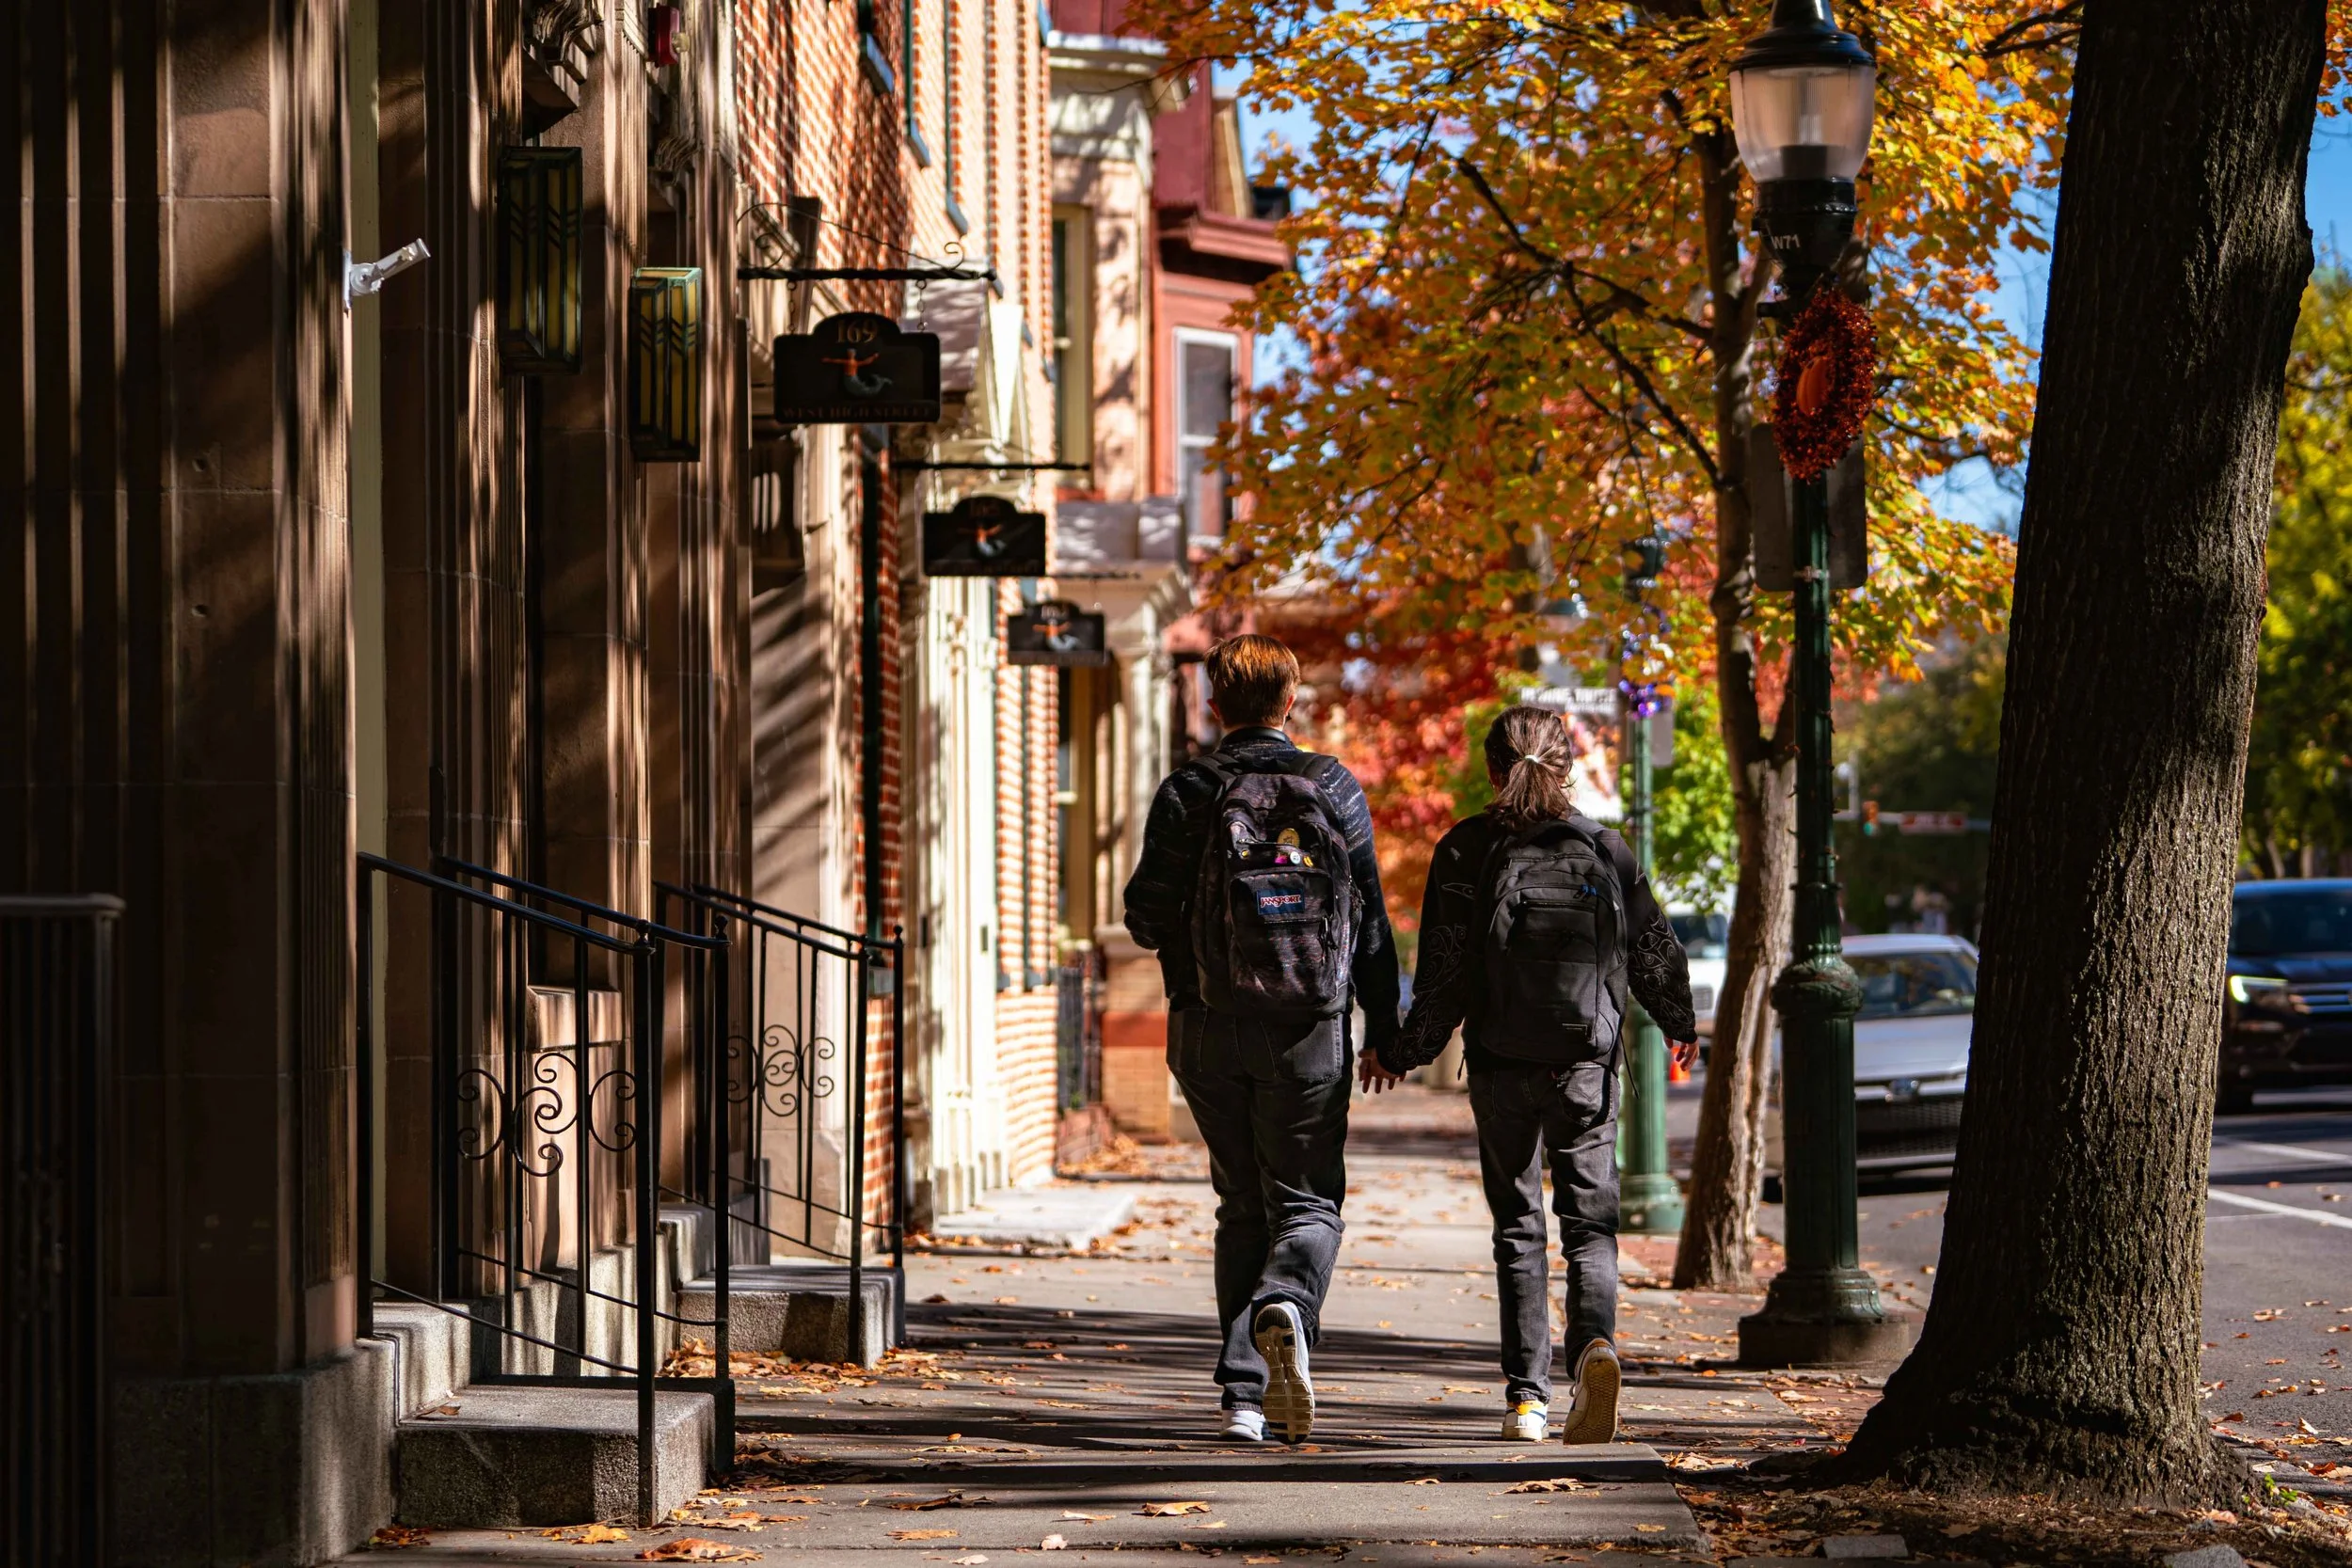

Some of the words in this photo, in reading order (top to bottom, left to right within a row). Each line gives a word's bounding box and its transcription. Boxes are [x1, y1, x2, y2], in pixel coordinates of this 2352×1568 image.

[1771, 234, 1801, 249] W71
[835, 319, 878, 343] 169
[1261, 895, 1302, 908] JANSPORT
